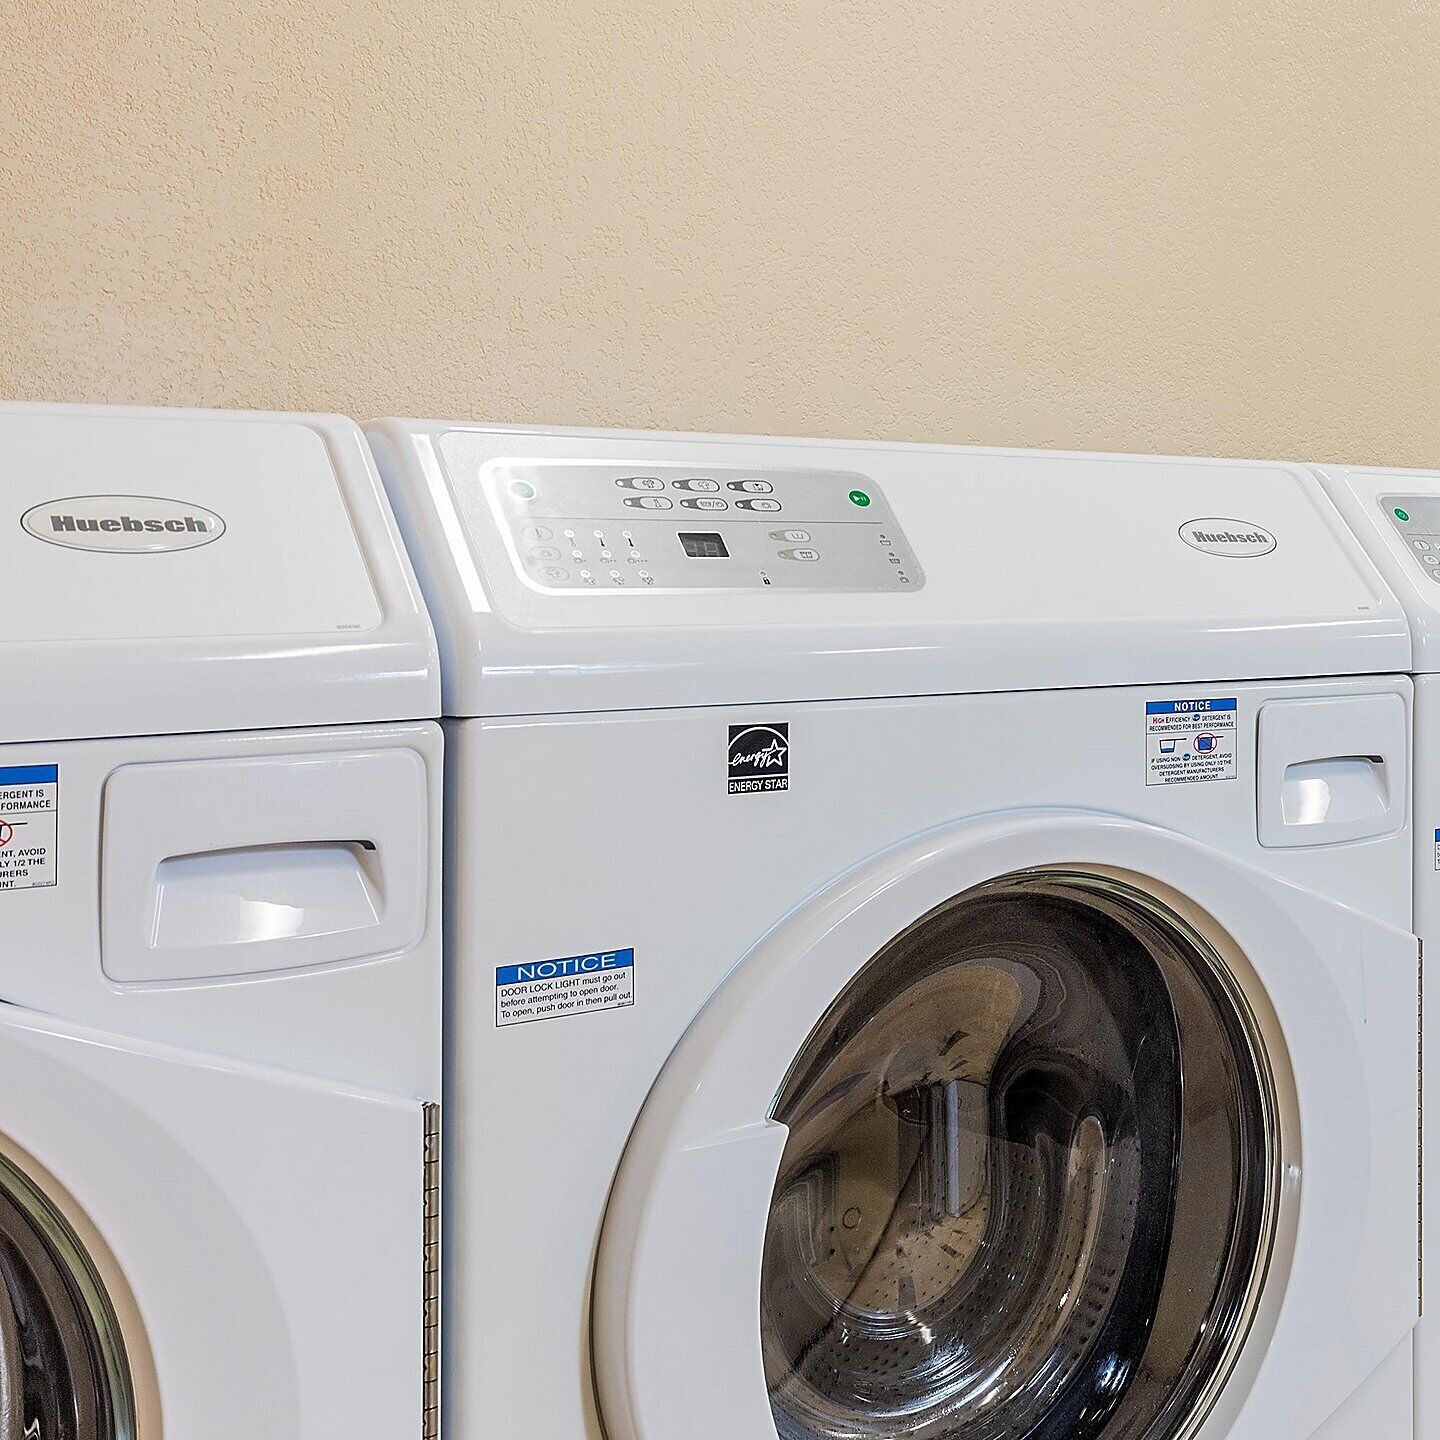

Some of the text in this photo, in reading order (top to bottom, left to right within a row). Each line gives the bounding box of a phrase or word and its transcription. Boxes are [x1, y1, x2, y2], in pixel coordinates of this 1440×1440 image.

[50, 515, 208, 533] Huebsch
[1191, 530, 1268, 543] Huebsch
[1174, 701, 1211, 711] NOTICE
[36, 789, 44, 797] IS
[729, 778, 788, 792] ENERGY STAR
[18, 848, 46, 856] AVOID
[518, 954, 616, 980] NOTICE
[501, 972, 626, 997] DOOR LOCK LIGHT must go out
[501, 998, 526, 1008] before
[528, 992, 568, 1004] attempting
[580, 988, 598, 996] open
[501, 1010, 510, 1018] To
[537, 1003, 555, 1014] push
[558, 1001, 574, 1010] door
[604, 994, 617, 1004] pull
